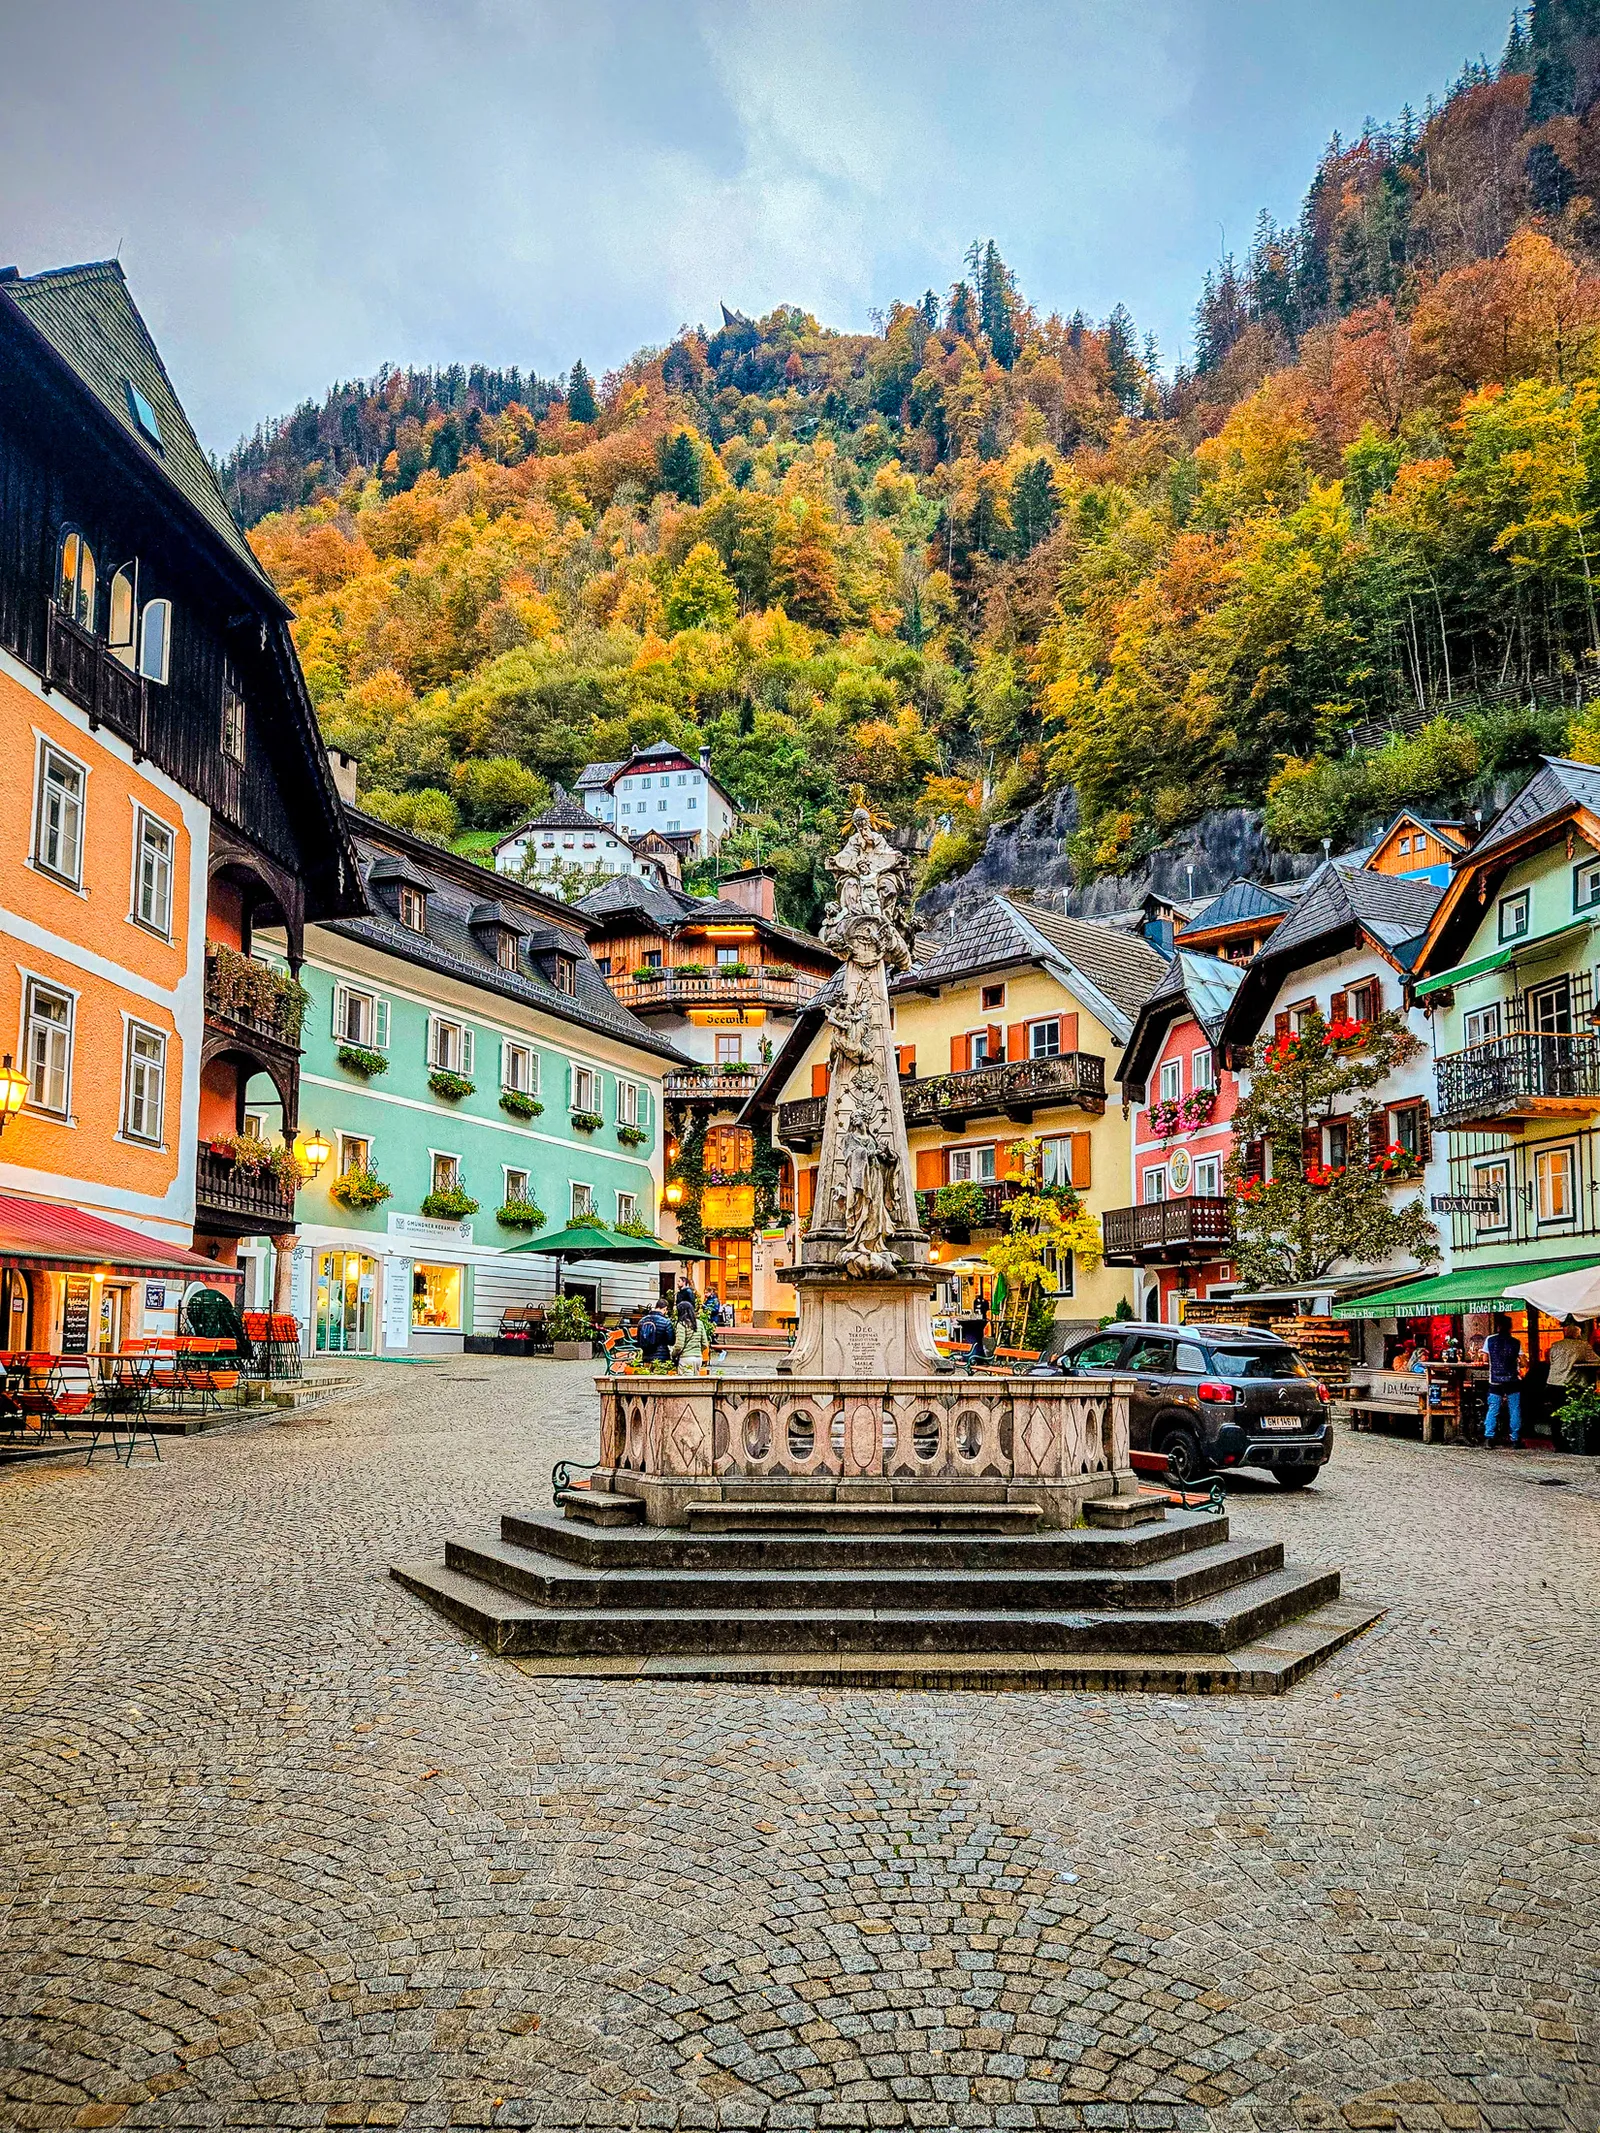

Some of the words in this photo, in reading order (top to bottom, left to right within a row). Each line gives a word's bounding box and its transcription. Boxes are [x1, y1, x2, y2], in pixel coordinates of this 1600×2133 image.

[1435, 1199, 1459, 1211] IDA
[1461, 1199, 1494, 1211] MITT
[1469, 1302, 1491, 1314] Hotel
[1498, 1301, 1513, 1312] Bar
